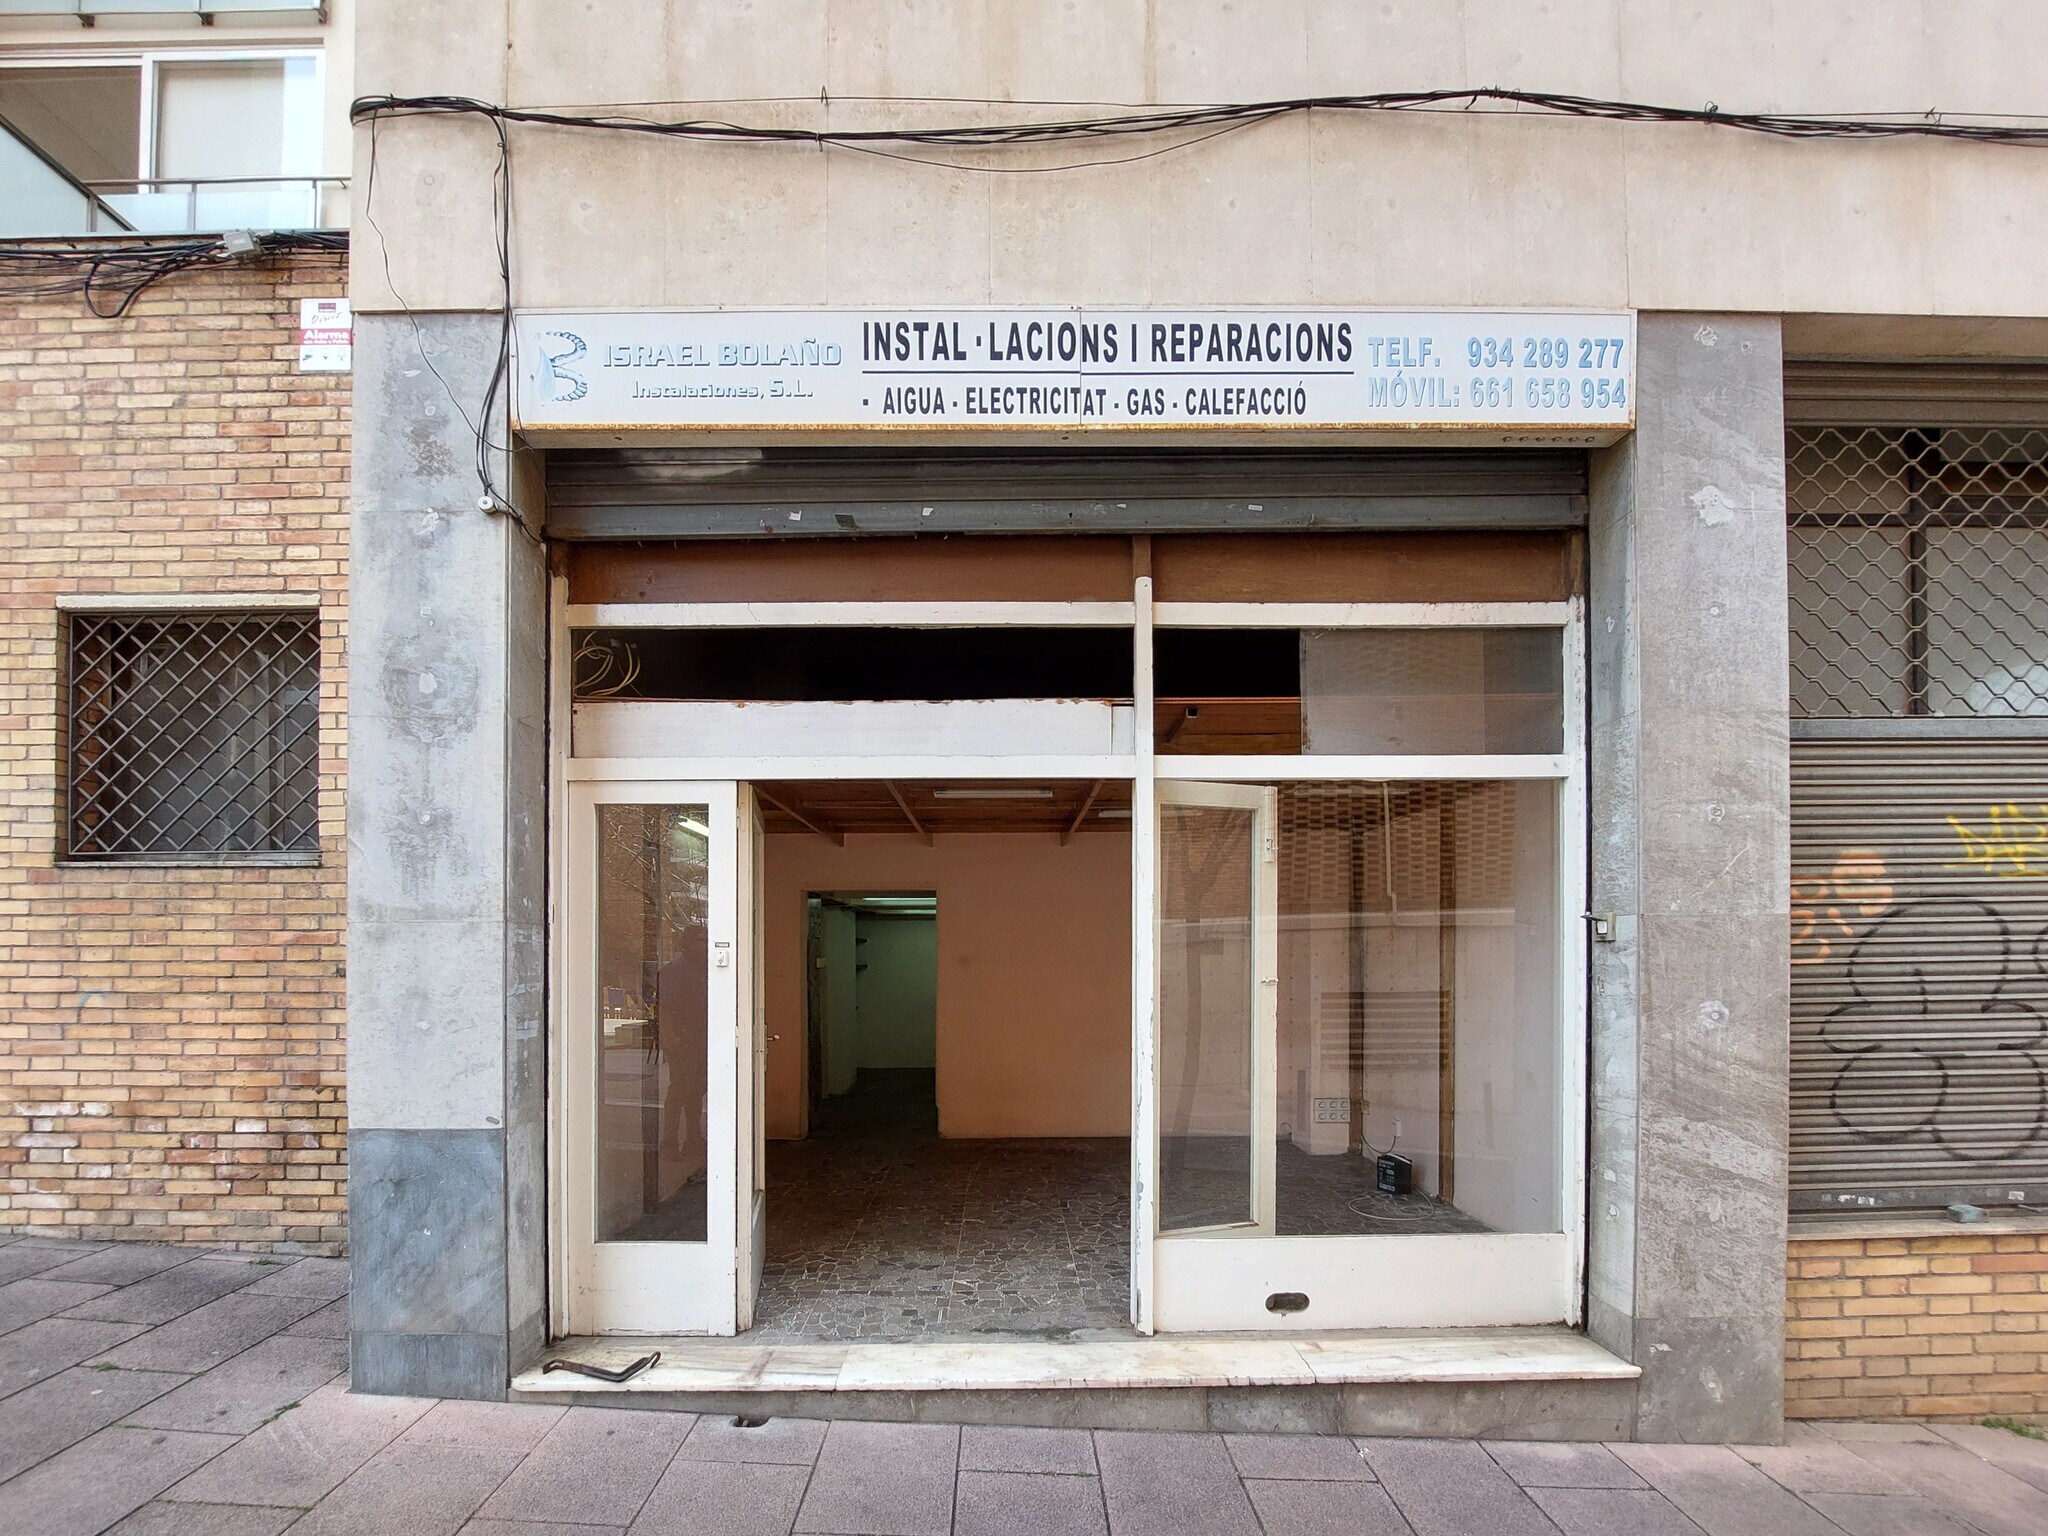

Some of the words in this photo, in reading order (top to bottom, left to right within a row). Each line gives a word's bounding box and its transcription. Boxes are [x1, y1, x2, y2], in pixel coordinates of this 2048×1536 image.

[303, 329, 349, 341] Alarma
[1131, 323, 1137, 363] I
[1151, 322, 1353, 363] REPARACIONS
[603, 343, 710, 367] ISRAEL
[717, 337, 842, 367] BOLAÑO
[1367, 337, 1440, 367] TELF.
[1467, 336, 1513, 368] 934
[1523, 337, 1569, 368] 289
[1578, 338, 1624, 368] 277
[631, 380, 765, 400] Instalaciones,
[768, 379, 813, 398] S.L.
[882, 386, 945, 415] AIGUA
[966, 387, 1107, 416] ELECTRICITAT
[1127, 388, 1165, 416] GAS
[1185, 381, 1307, 416] CALEFACCIÓ
[1367, 370, 1460, 408] MÓVIL:
[1470, 377, 1513, 408] 661
[1526, 377, 1571, 408] 658
[1581, 377, 1626, 408] 954
